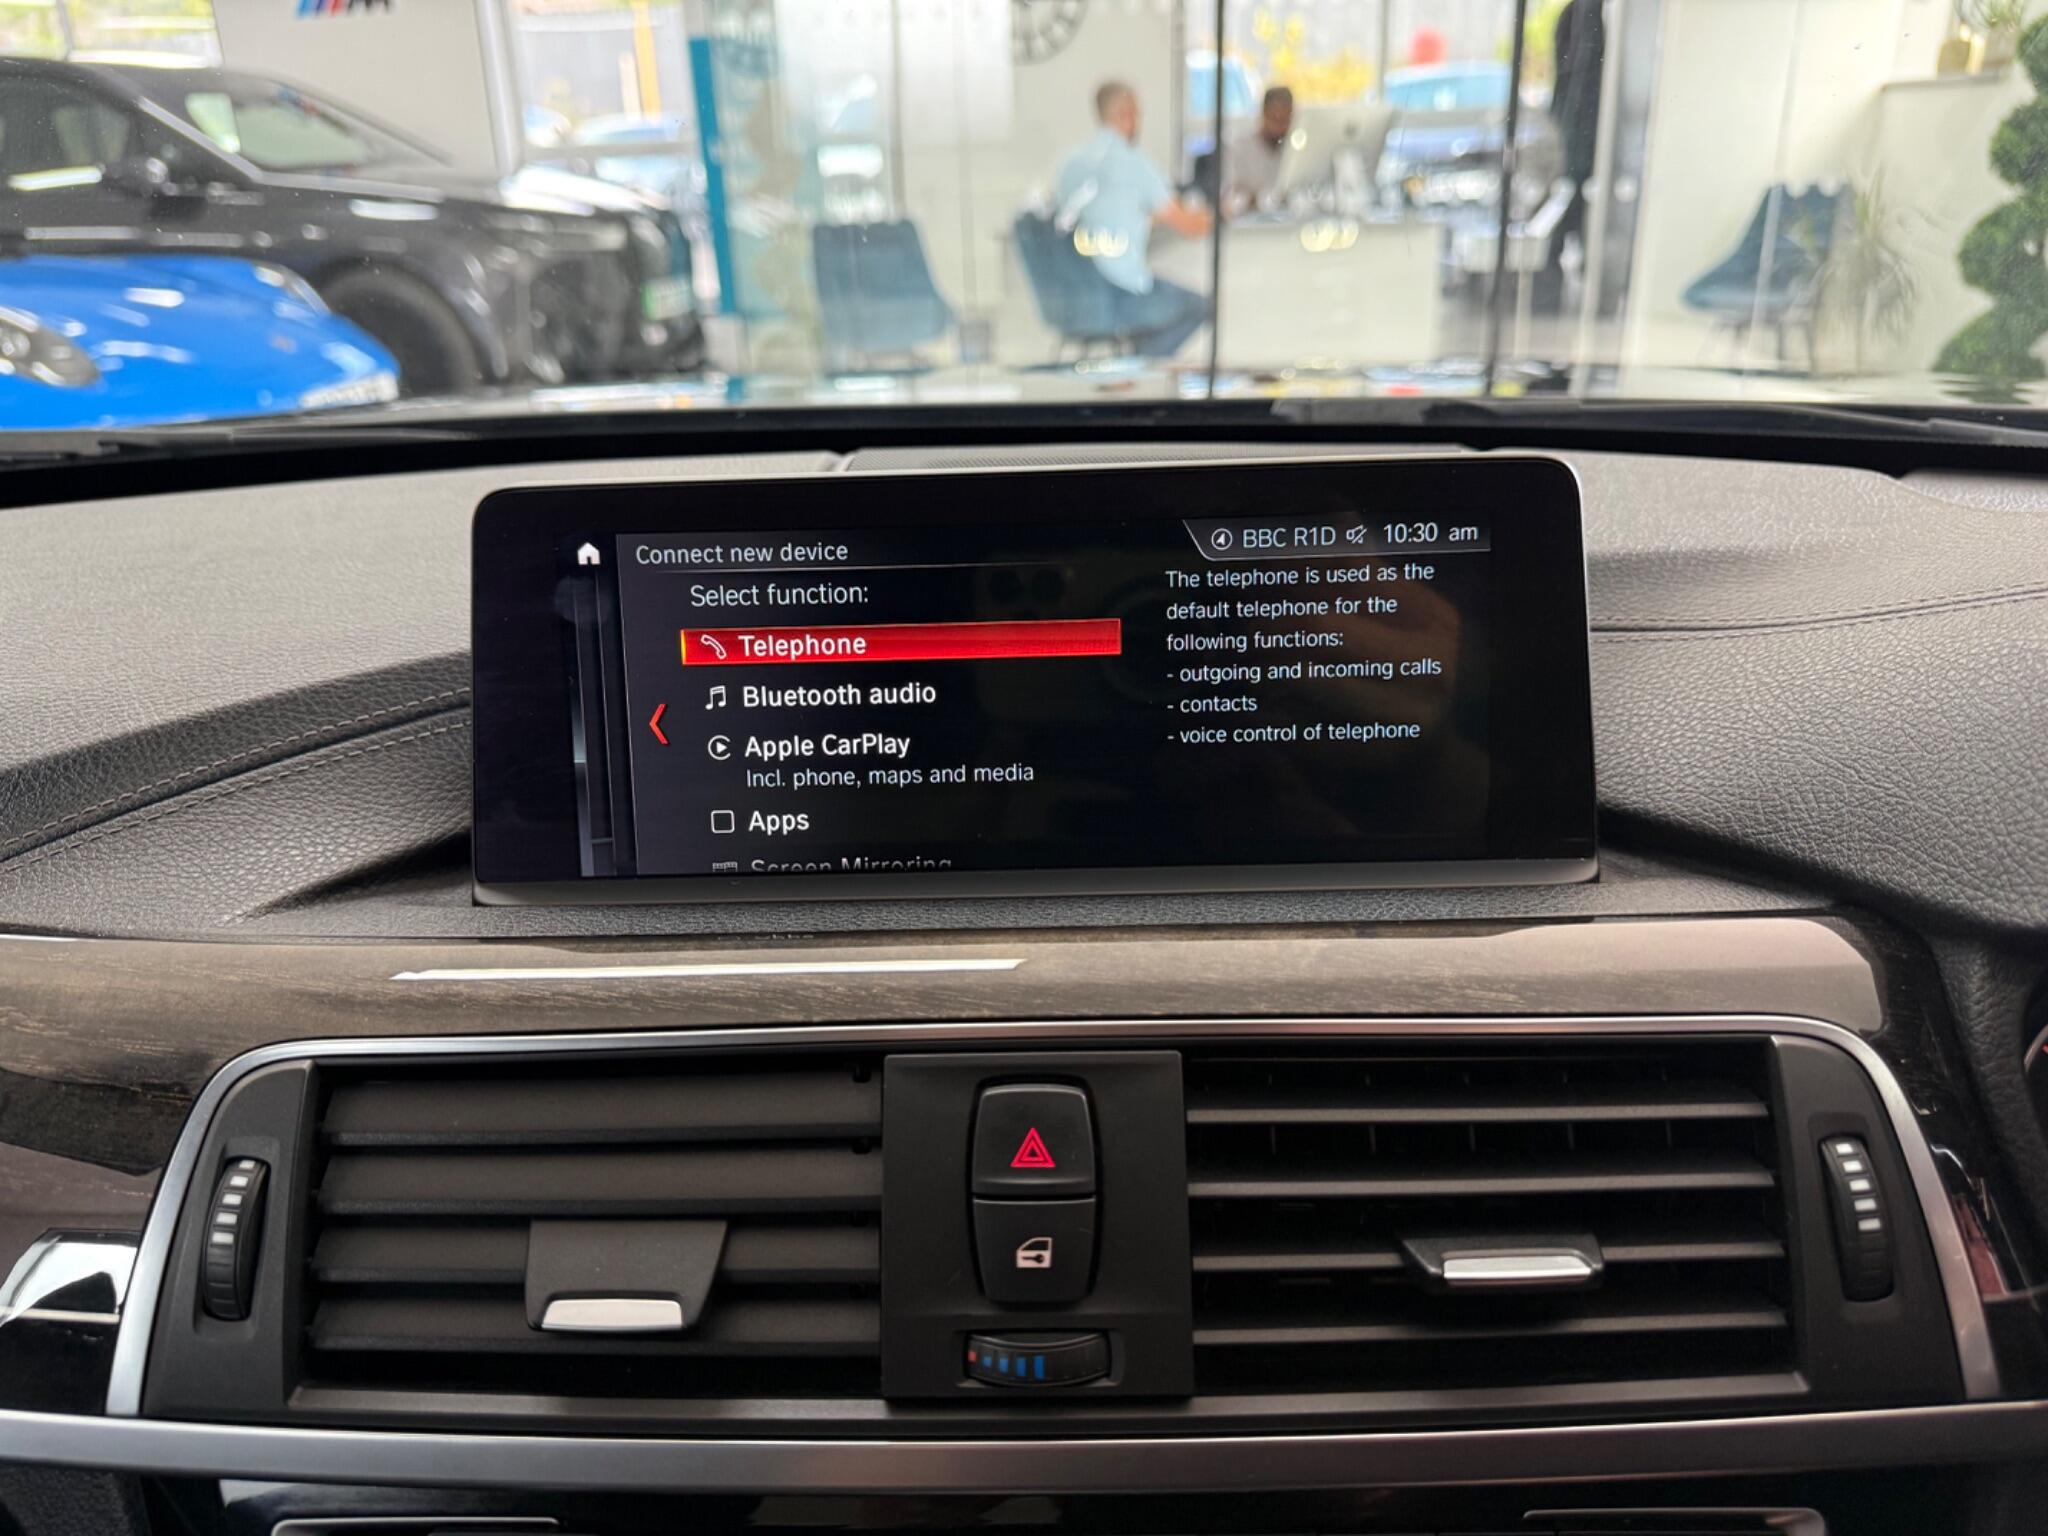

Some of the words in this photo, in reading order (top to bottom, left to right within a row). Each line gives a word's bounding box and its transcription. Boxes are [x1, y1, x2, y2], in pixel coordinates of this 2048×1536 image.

[1243, 527, 1286, 548] BBC
[1294, 526, 1336, 547] R1D
[1383, 522, 1438, 543] 10:30
[1449, 526, 1478, 542] am
[636, 545, 724, 565] Connect
[730, 547, 774, 562] new
[780, 542, 848, 562] device
[1165, 570, 1200, 588] The
[1207, 569, 1299, 589] telephone
[1305, 567, 1320, 584] is
[1326, 564, 1370, 583] used
[1376, 567, 1398, 581] as
[1403, 563, 1434, 580] the
[690, 584, 760, 607] Select
[767, 583, 868, 605] function:
[1166, 601, 1230, 620] default
[1236, 599, 1329, 620] telephone
[1335, 597, 1362, 614] for
[1366, 596, 1398, 613] the
[737, 634, 867, 661] Telephone
[1166, 634, 1247, 653] following
[1254, 631, 1344, 649] functions:
[1179, 665, 1261, 685] outgoing
[1267, 662, 1302, 679] and
[1308, 660, 1393, 680] incoming
[1400, 657, 1442, 676] calls
[743, 683, 861, 708] Bluetooth
[869, 682, 936, 705] audio
[1179, 695, 1257, 713] contacts
[1179, 726, 1227, 743] voice
[1233, 724, 1296, 742] control
[1303, 723, 1322, 741] of
[1328, 722, 1421, 743] telephone
[744, 735, 814, 762] Apple
[821, 733, 910, 759] CarPlay
[746, 769, 787, 788] Incl.
[793, 768, 861, 790] phone,
[869, 769, 923, 788] maps
[929, 764, 966, 783] and
[974, 763, 1034, 782] media
[748, 810, 810, 836] Apps
